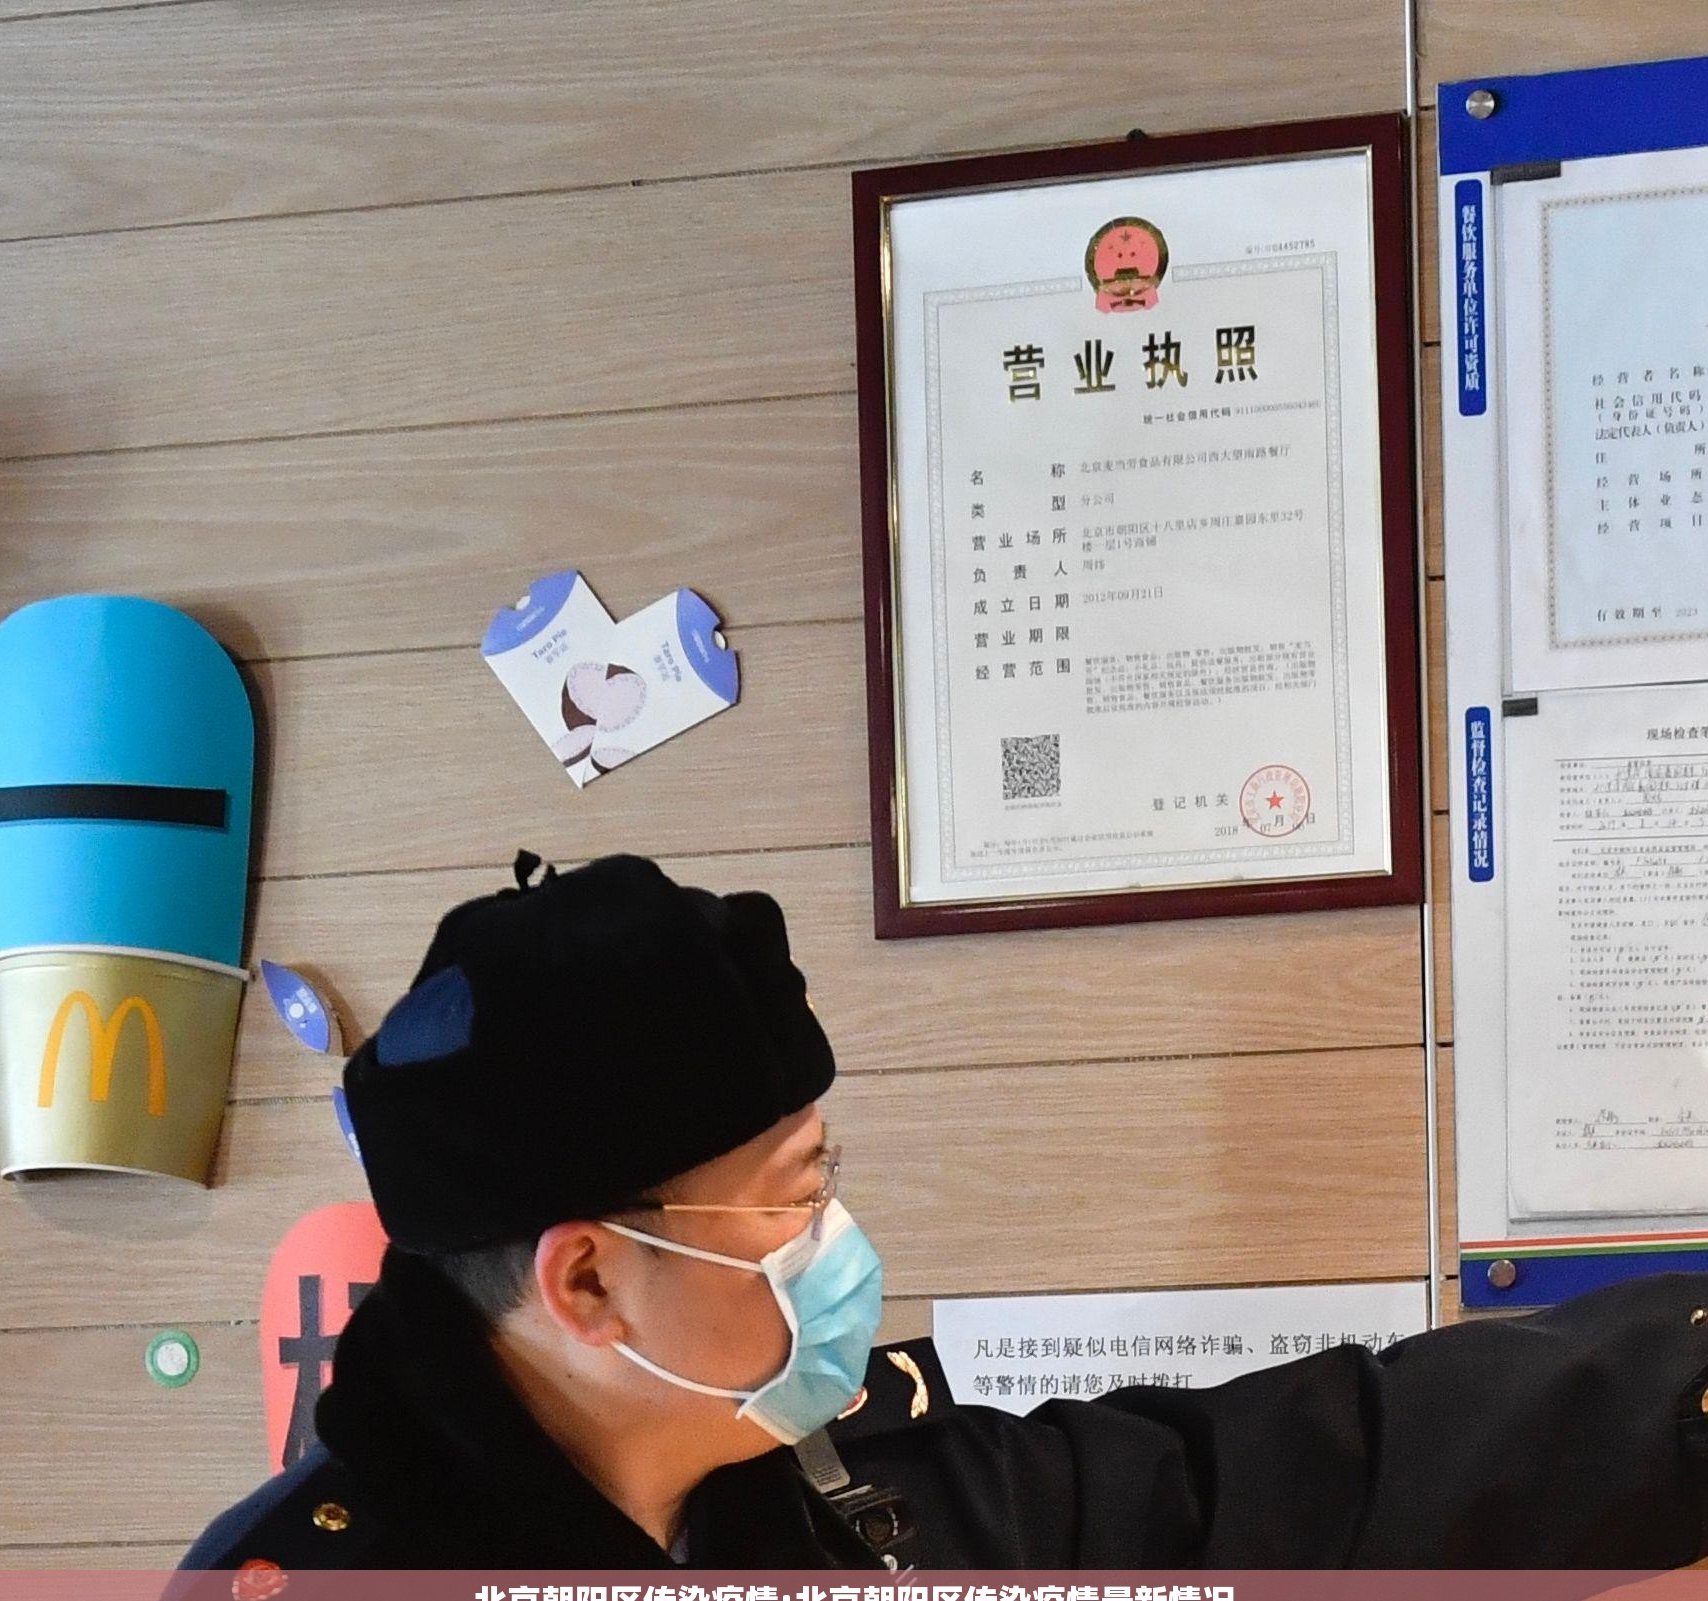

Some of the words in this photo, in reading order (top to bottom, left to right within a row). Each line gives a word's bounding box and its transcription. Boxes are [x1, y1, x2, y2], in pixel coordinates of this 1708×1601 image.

[1461, 205, 1480, 391] 餐饮服务单位许可资质
[1003, 325, 1258, 403] 营业执照
[972, 528, 1067, 551] 营业场所
[973, 561, 1069, 584] 负责人
[973, 594, 1070, 616] 成立日期
[974, 626, 1070, 649] 营业期限
[975, 658, 1071, 680] 经营范围
[1153, 794, 1230, 811] 登记机关
[1470, 720, 1489, 868] 监督检查记录情况
